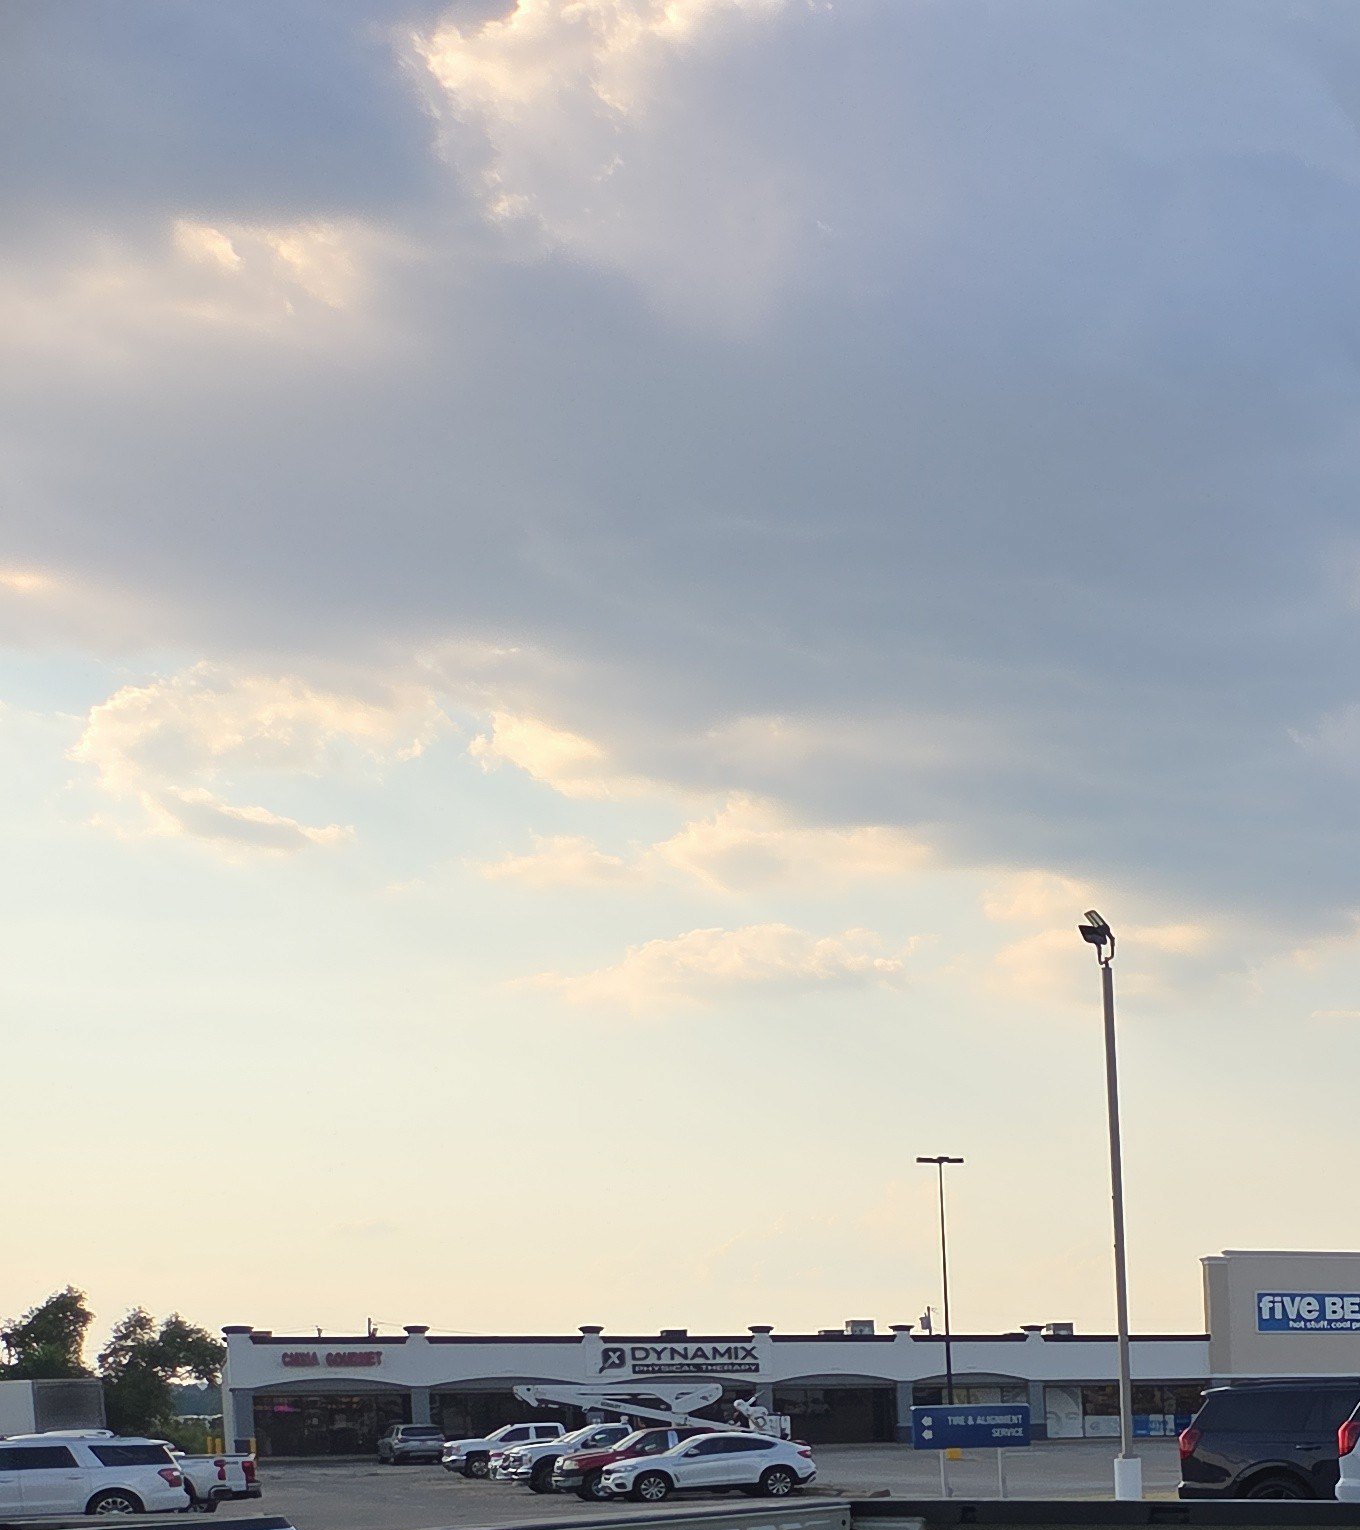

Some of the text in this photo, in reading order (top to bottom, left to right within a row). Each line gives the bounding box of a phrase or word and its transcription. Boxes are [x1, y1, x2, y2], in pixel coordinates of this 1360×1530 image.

[1259, 1295, 1320, 1320] five
[1289, 1320, 1305, 1328] hot
[1331, 1320, 1350, 1329] cool
[631, 1345, 759, 1361] DYNAMIX
[635, 1363, 757, 1372] PHYSICAL THERAPY
